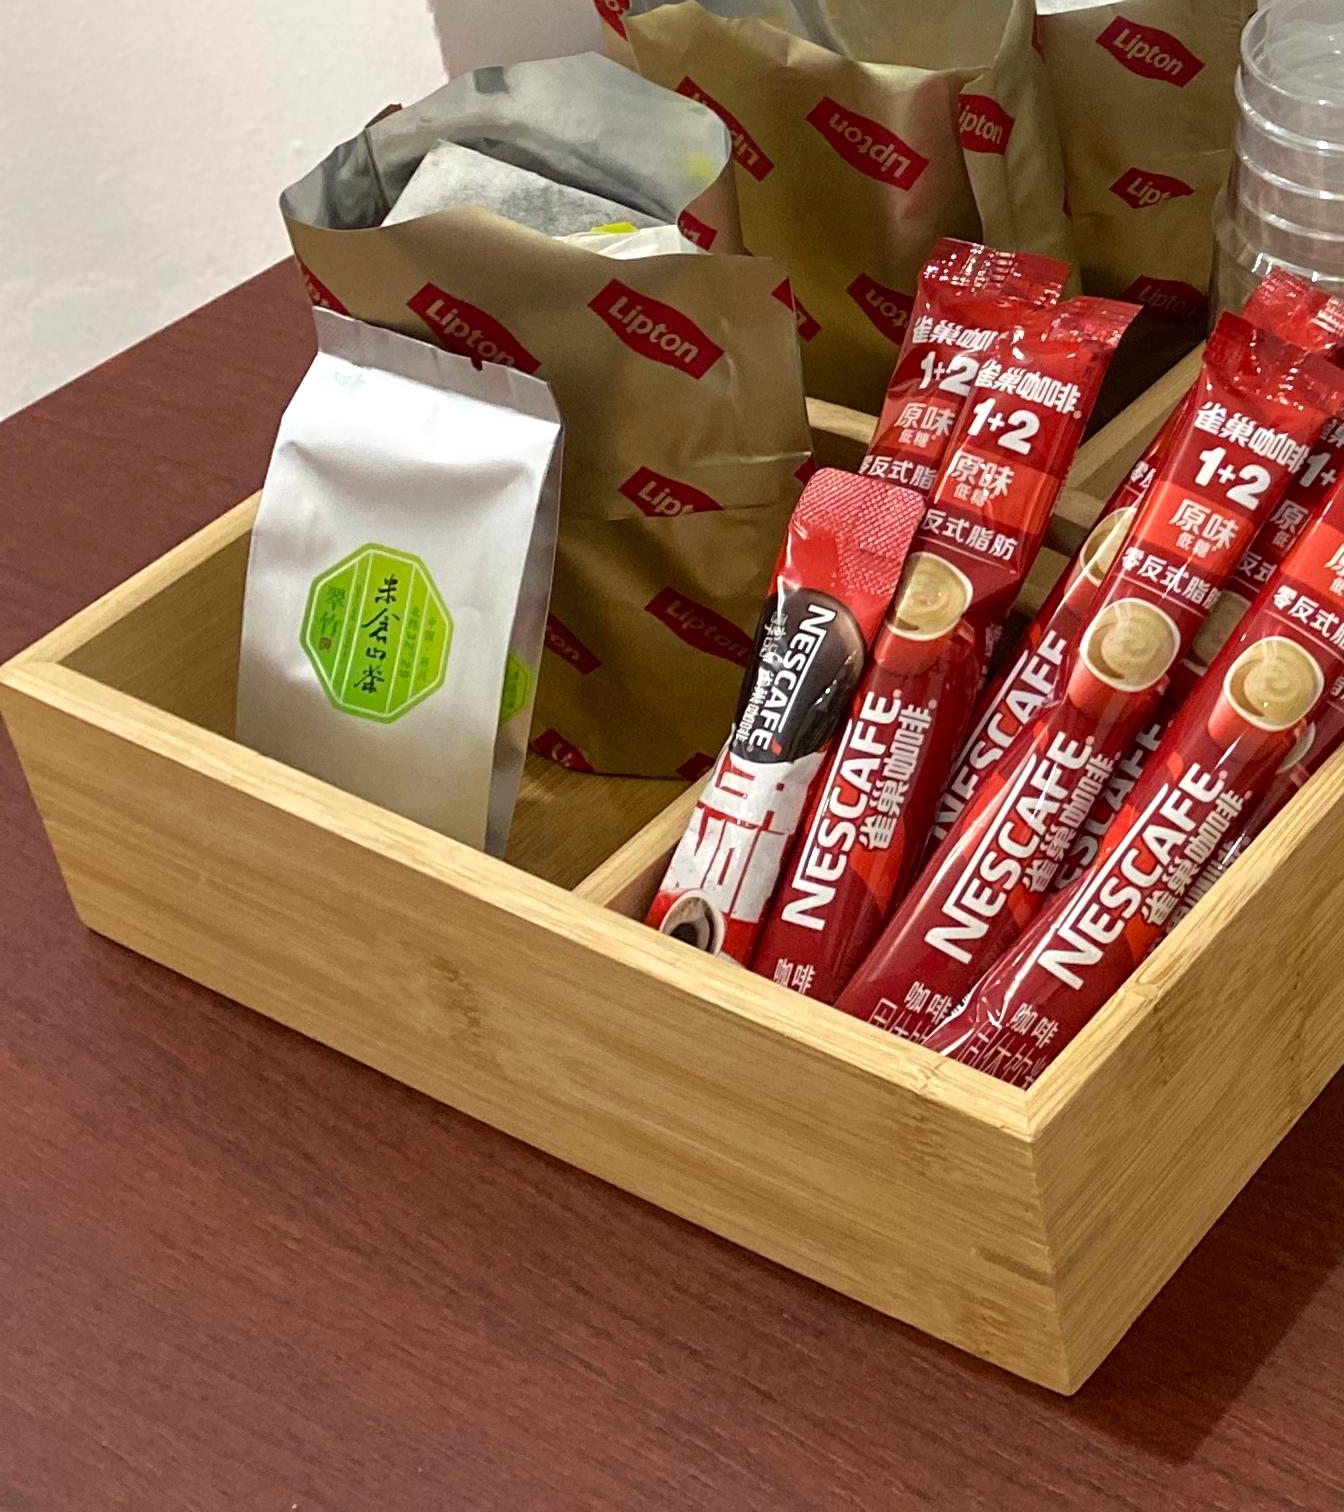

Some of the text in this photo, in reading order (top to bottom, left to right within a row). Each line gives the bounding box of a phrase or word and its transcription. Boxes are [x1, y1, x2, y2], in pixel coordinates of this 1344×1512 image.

[1112, 28, 1184, 76] Lipton
[828, 112, 912, 179] Lipton
[958, 105, 1004, 145] ipton
[607, 296, 700, 364] Lipton
[912, 315, 999, 353] 雀巢咖
[919, 350, 980, 397] 1+2
[974, 359, 1081, 415] 雀巢咖啡
[894, 402, 955, 437] 原味
[968, 398, 1040, 456] 1+2
[1194, 401, 1311, 475] 雀巢咖啡
[951, 451, 1015, 497] 原味
[1194, 447, 1271, 511] 1+2
[1299, 452, 1337, 488] 1+
[921, 509, 1018, 561] 反式脂肪
[1169, 498, 1240, 551] 原味
[666, 600, 748, 658] Lipton
[859, 703, 933, 850] 雀巢咖啡
[1022, 752, 1116, 893] 雀巢咖啡
[1140, 787, 1248, 926] 雀巢咖啡
[1007, 1002, 1060, 1049] 咖啡
